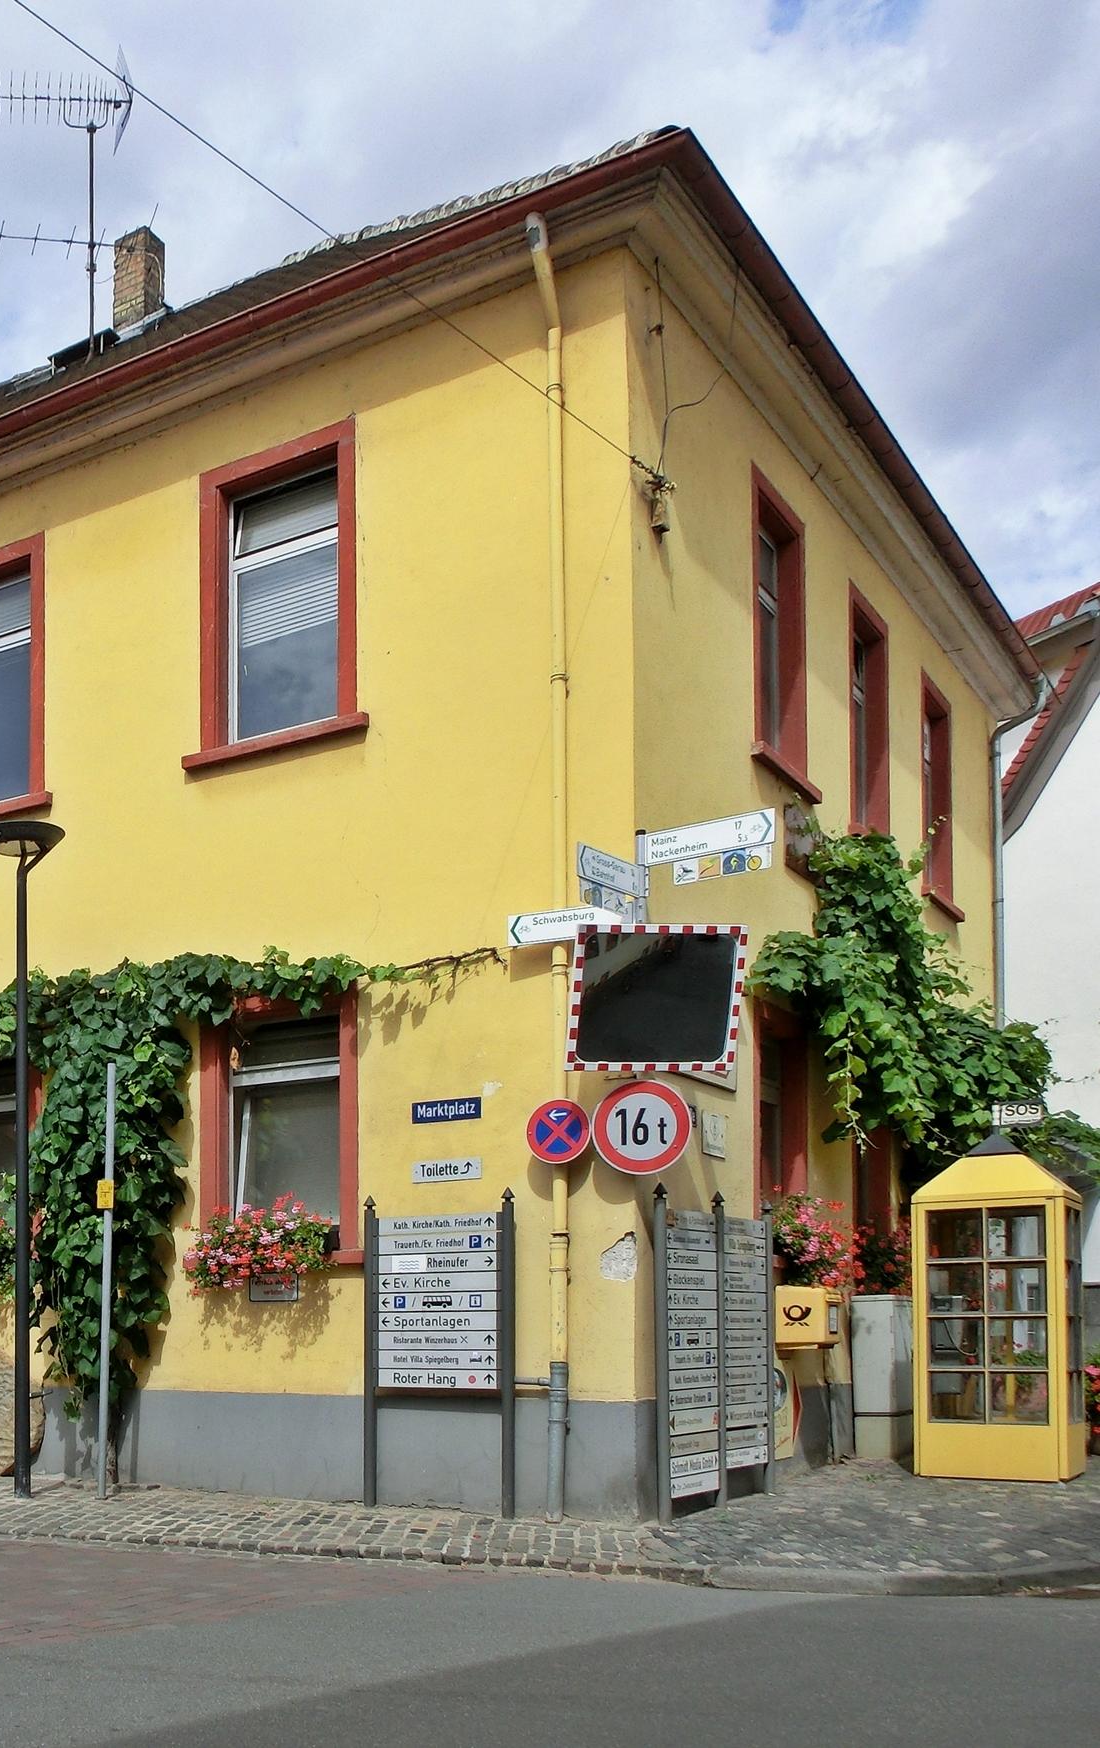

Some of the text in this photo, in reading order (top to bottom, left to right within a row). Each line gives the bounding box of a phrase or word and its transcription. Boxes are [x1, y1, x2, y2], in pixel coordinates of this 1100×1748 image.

[651, 821, 743, 848] Mainz 17
[651, 842, 709, 860] Nackenheim
[532, 912, 595, 926] Schwabsburg
[417, 1101, 476, 1119] Marktplatz
[1005, 1103, 1039, 1116] SOS
[615, 1107, 667, 1146] 16 t
[420, 1163, 459, 1178] Toilette
[393, 1216, 483, 1230] Kath. Kirche/Kath. Friedhof
[435, 1237, 465, 1248] Friedhof
[426, 1256, 469, 1269] Rheinufer
[393, 1275, 452, 1289] Ev. Kirche
[673, 1293, 699, 1305] Ev. Kirche
[393, 1315, 471, 1329] Sportanlagen
[674, 1313, 707, 1327] Sportanlagen
[393, 1335, 458, 1344] Ristorante Winzerhaus
[393, 1355, 460, 1365] Hotel Villa Spiegelberg
[393, 1372, 457, 1387] Roter Hang
